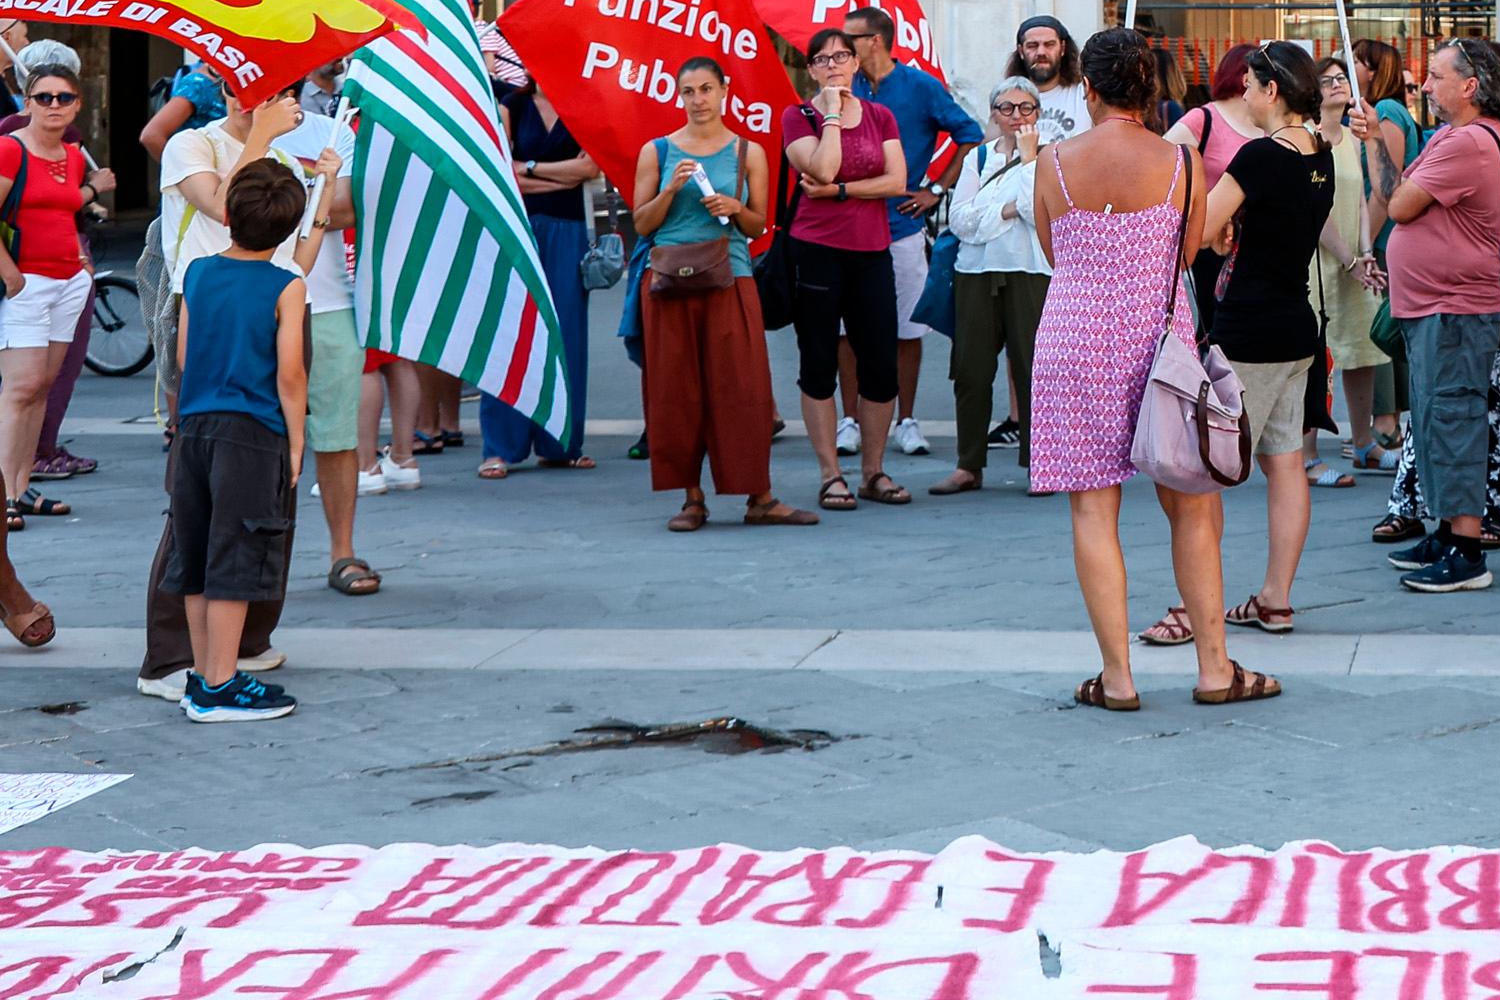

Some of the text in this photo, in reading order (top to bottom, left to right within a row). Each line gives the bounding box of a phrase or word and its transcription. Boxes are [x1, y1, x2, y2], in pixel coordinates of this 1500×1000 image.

[119, 1, 169, 24] DI
[168, 18, 264, 89] BASE
[963, 849, 1053, 932] E
